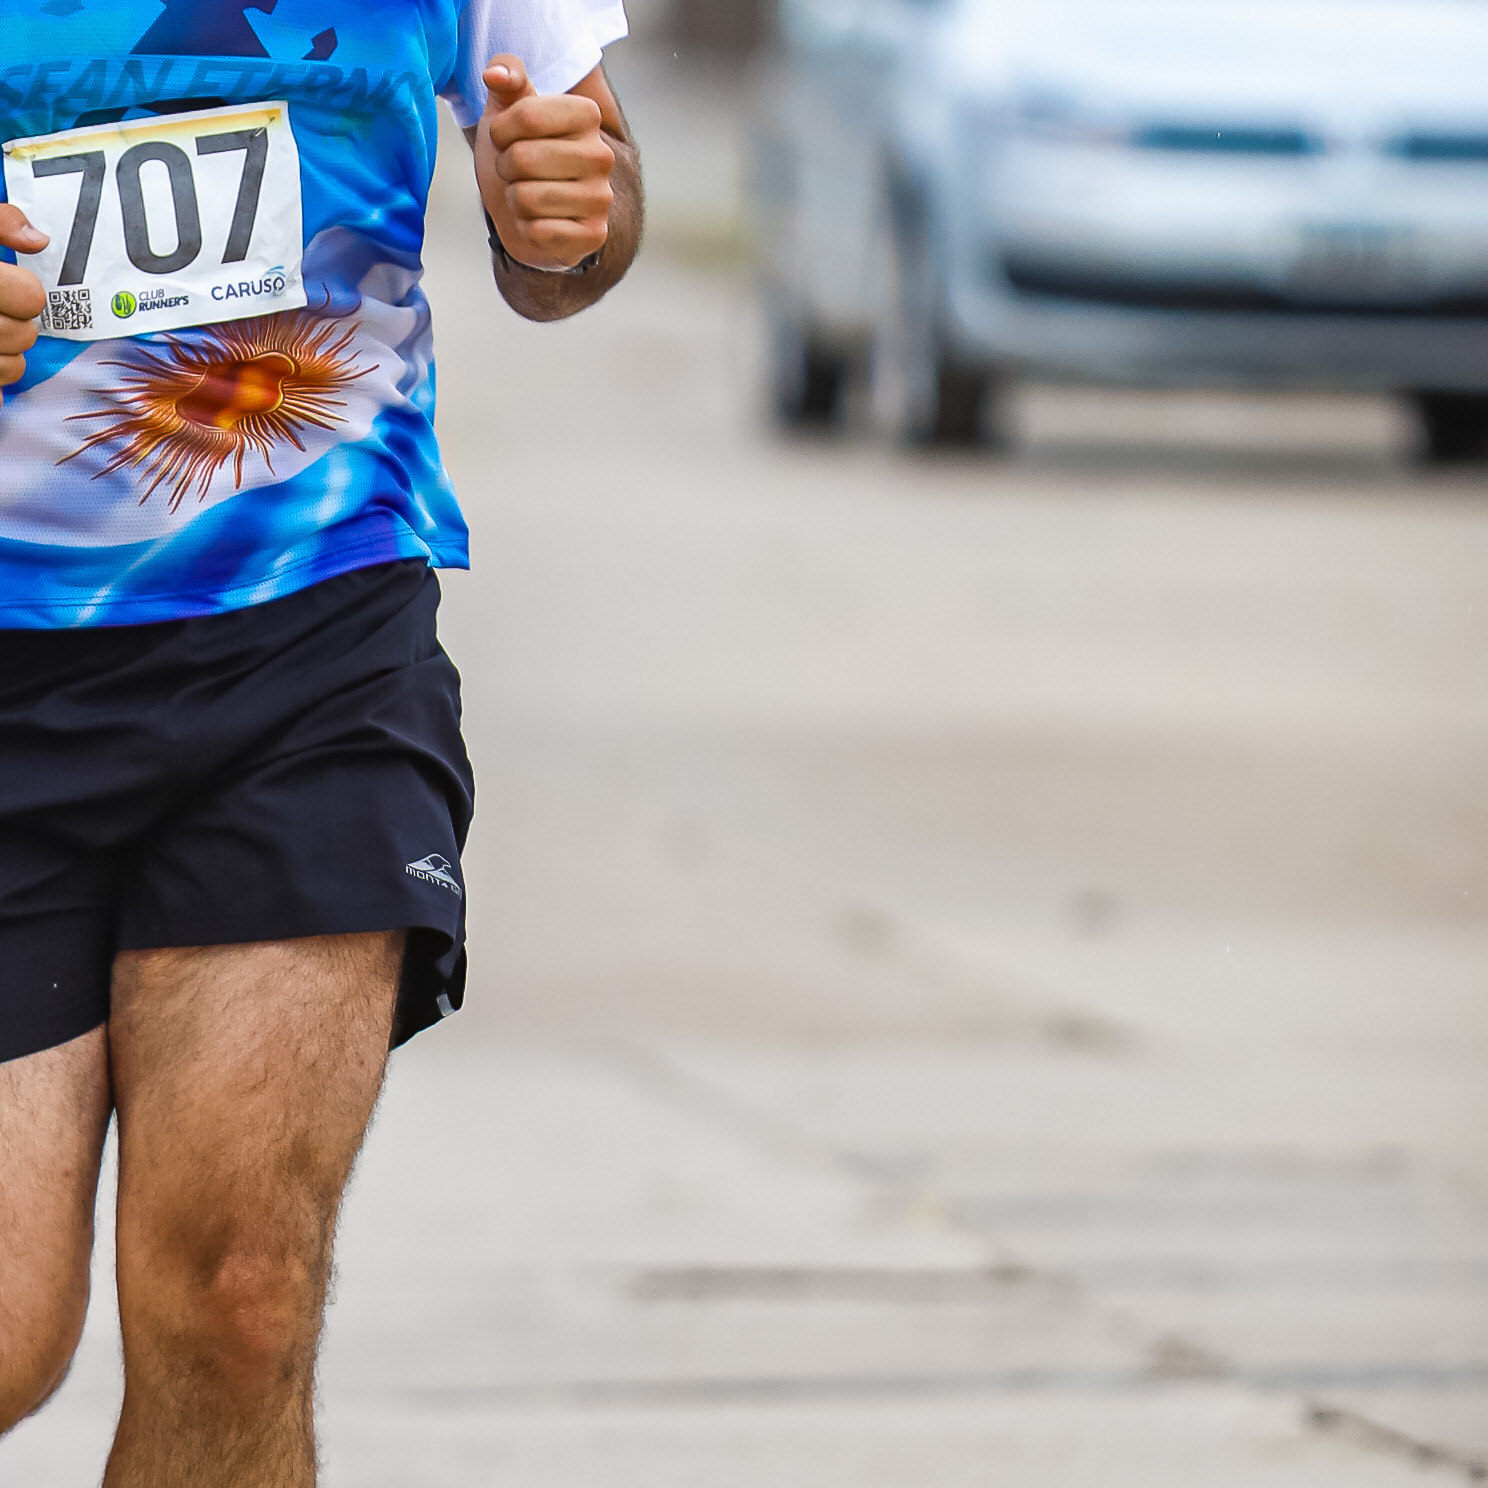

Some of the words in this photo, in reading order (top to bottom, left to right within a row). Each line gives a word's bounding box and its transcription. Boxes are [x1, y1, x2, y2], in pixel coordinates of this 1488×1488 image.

[32, 127, 269, 286] 707
[138, 288, 165, 302] CLUB
[211, 276, 285, 302] CARUSO
[138, 295, 190, 312] RUNNER'S
